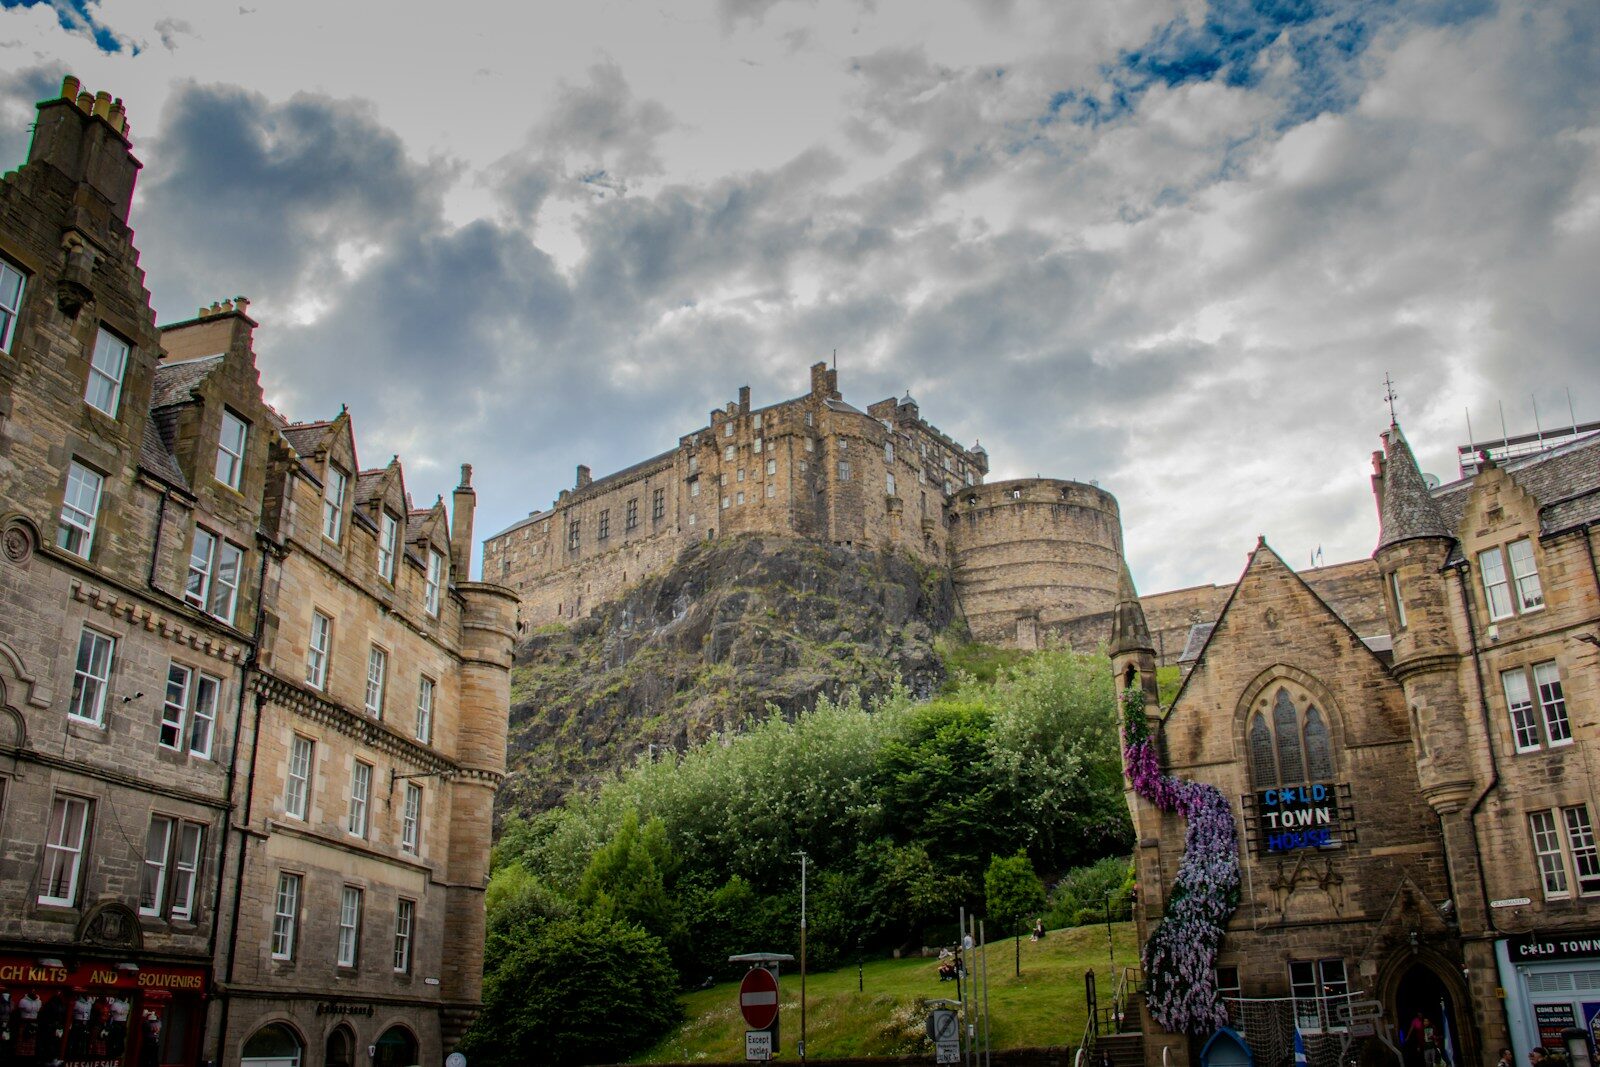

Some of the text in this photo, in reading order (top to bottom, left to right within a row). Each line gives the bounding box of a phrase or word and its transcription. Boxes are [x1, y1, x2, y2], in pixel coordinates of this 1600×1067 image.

[1267, 807, 1331, 828] TOWN
[1268, 828, 1332, 851] HOUSE
[1560, 939, 1600, 953] TOWN
[28, 966, 68, 982] KILTS
[89, 969, 119, 985] AND
[137, 972, 202, 988] SOUVENIRS
[748, 1035, 769, 1045] Except
[749, 1046, 769, 1055] cycles
